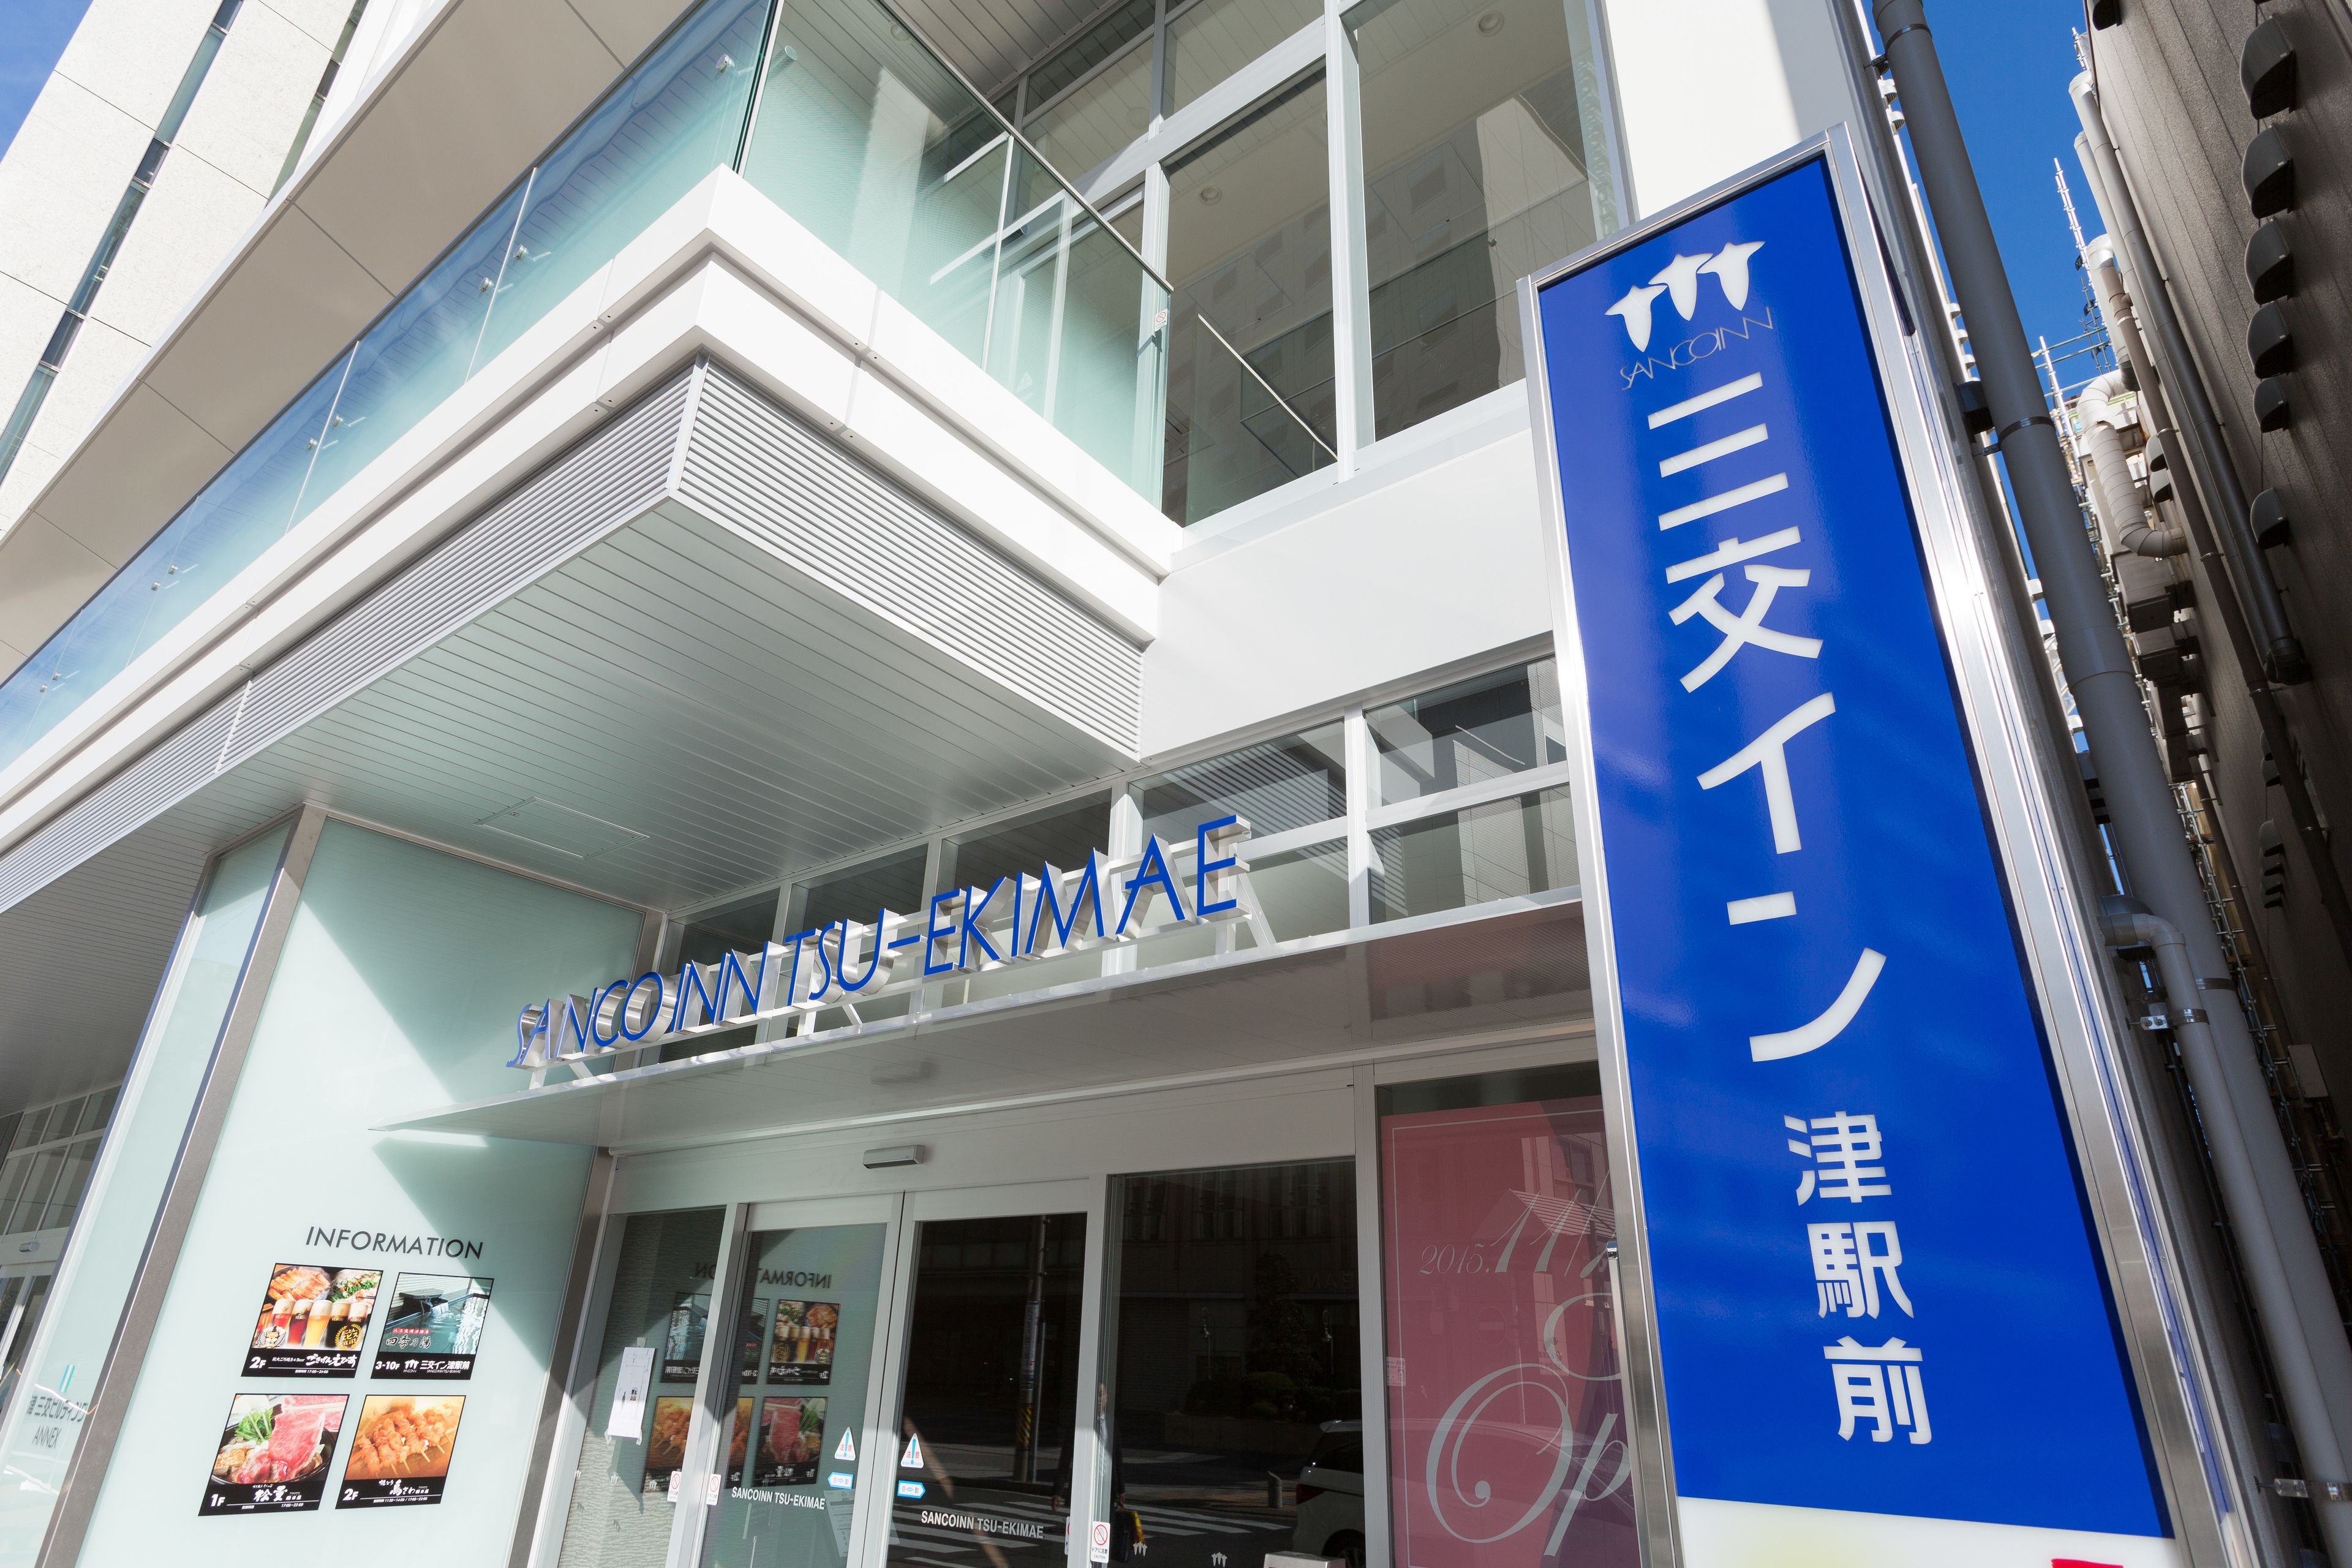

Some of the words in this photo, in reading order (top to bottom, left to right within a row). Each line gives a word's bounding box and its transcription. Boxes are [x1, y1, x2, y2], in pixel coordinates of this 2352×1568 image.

[1620, 306, 1773, 390] SANCOINN
[1648, 371, 1887, 1063] 三交イン
[1784, 1110, 1932, 1444] 津駅前
[506, 941, 770, 1068] SANCOINN
[785, 815, 1240, 1006] TSU-EKIMAE
[306, 1226, 484, 1260] INFORMATION
[249, 1356, 267, 1369] 2F
[420, 1360, 470, 1370] 三交イン津駅前
[31, 1425, 62, 1449] ANNEX
[210, 1493, 225, 1507] 1F
[342, 1488, 359, 1501] 2F
[731, 1486, 774, 1503] SANCOINN
[774, 1491, 826, 1510] TSU-EKIMAE
[921, 1510, 974, 1530] SANCOINN
[977, 1517, 1044, 1539] TSU-EKIMAE
